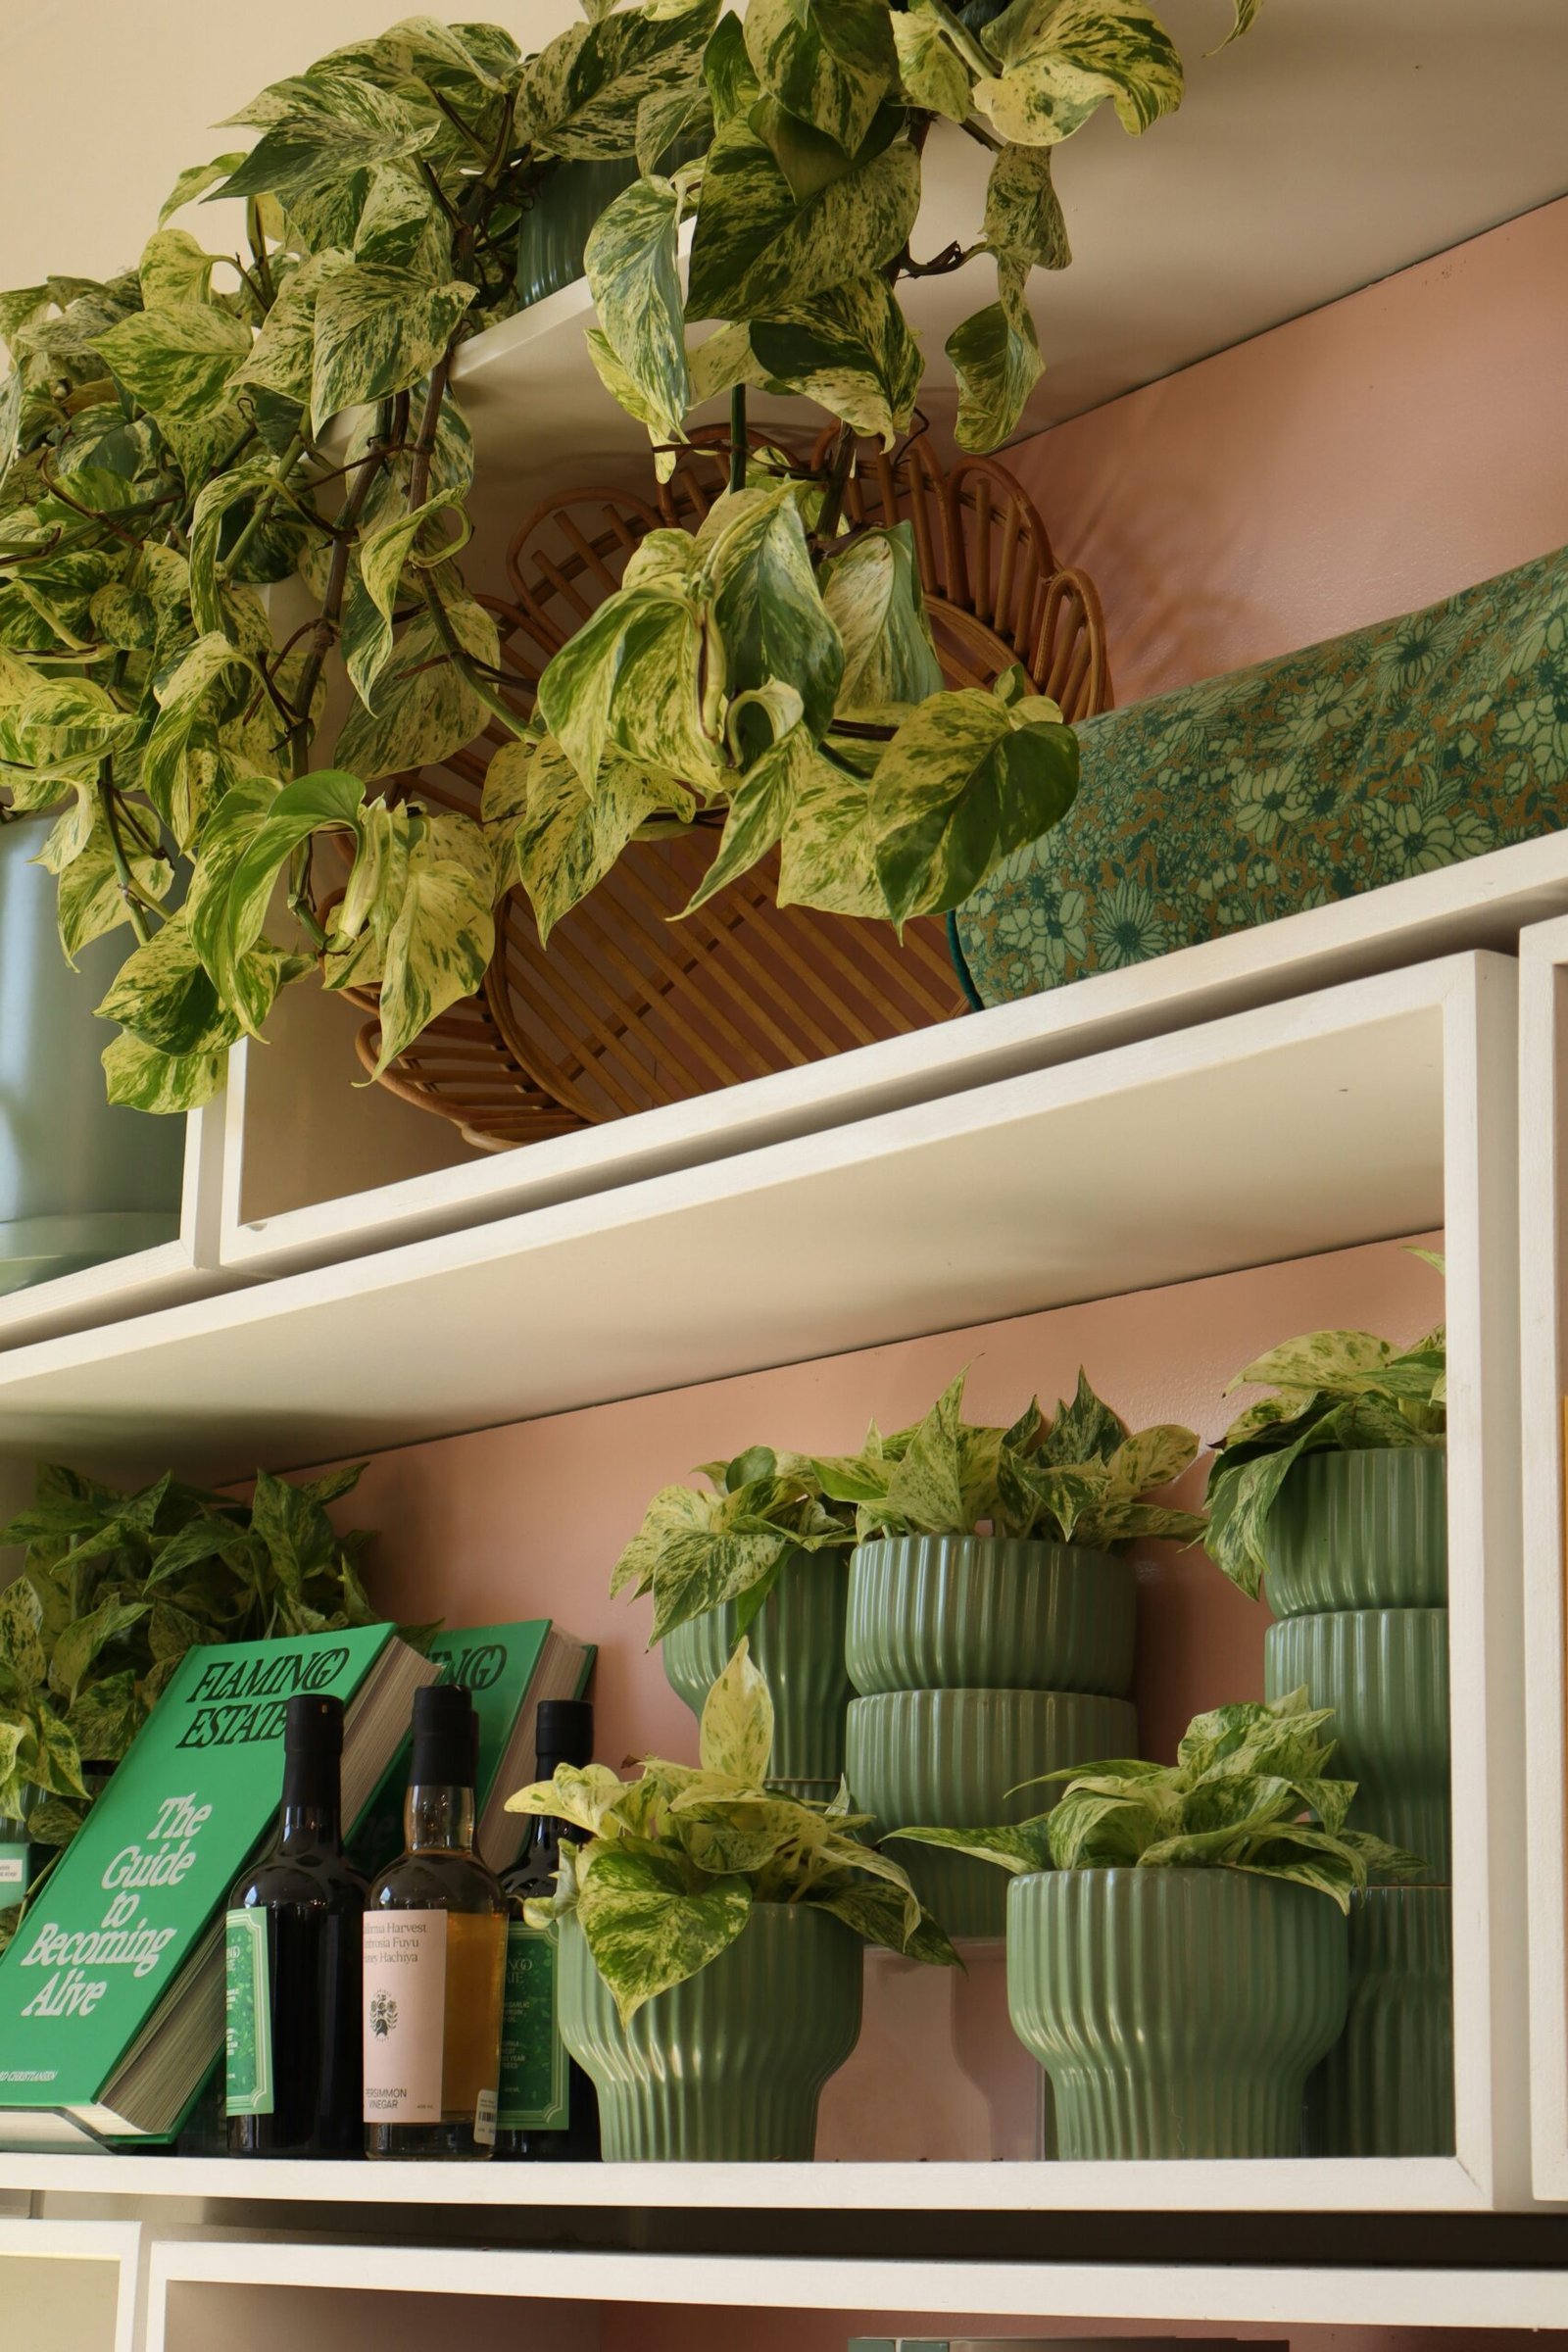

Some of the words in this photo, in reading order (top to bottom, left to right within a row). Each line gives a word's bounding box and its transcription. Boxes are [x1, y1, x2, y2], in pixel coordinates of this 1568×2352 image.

[185, 1647, 350, 1703] FLAMINGO
[147, 1792, 213, 1840] The
[101, 1839, 197, 1890] Guide
[101, 1890, 141, 1929] to
[386, 1922, 428, 1935] Harvest
[20, 1917, 178, 1979] Becoming
[379, 1950, 419, 1965] Hachiya
[392, 1936, 419, 1950] Fuyu
[21, 1967, 108, 2017] Alive
[368, 2099, 400, 2110] VINEGAR
